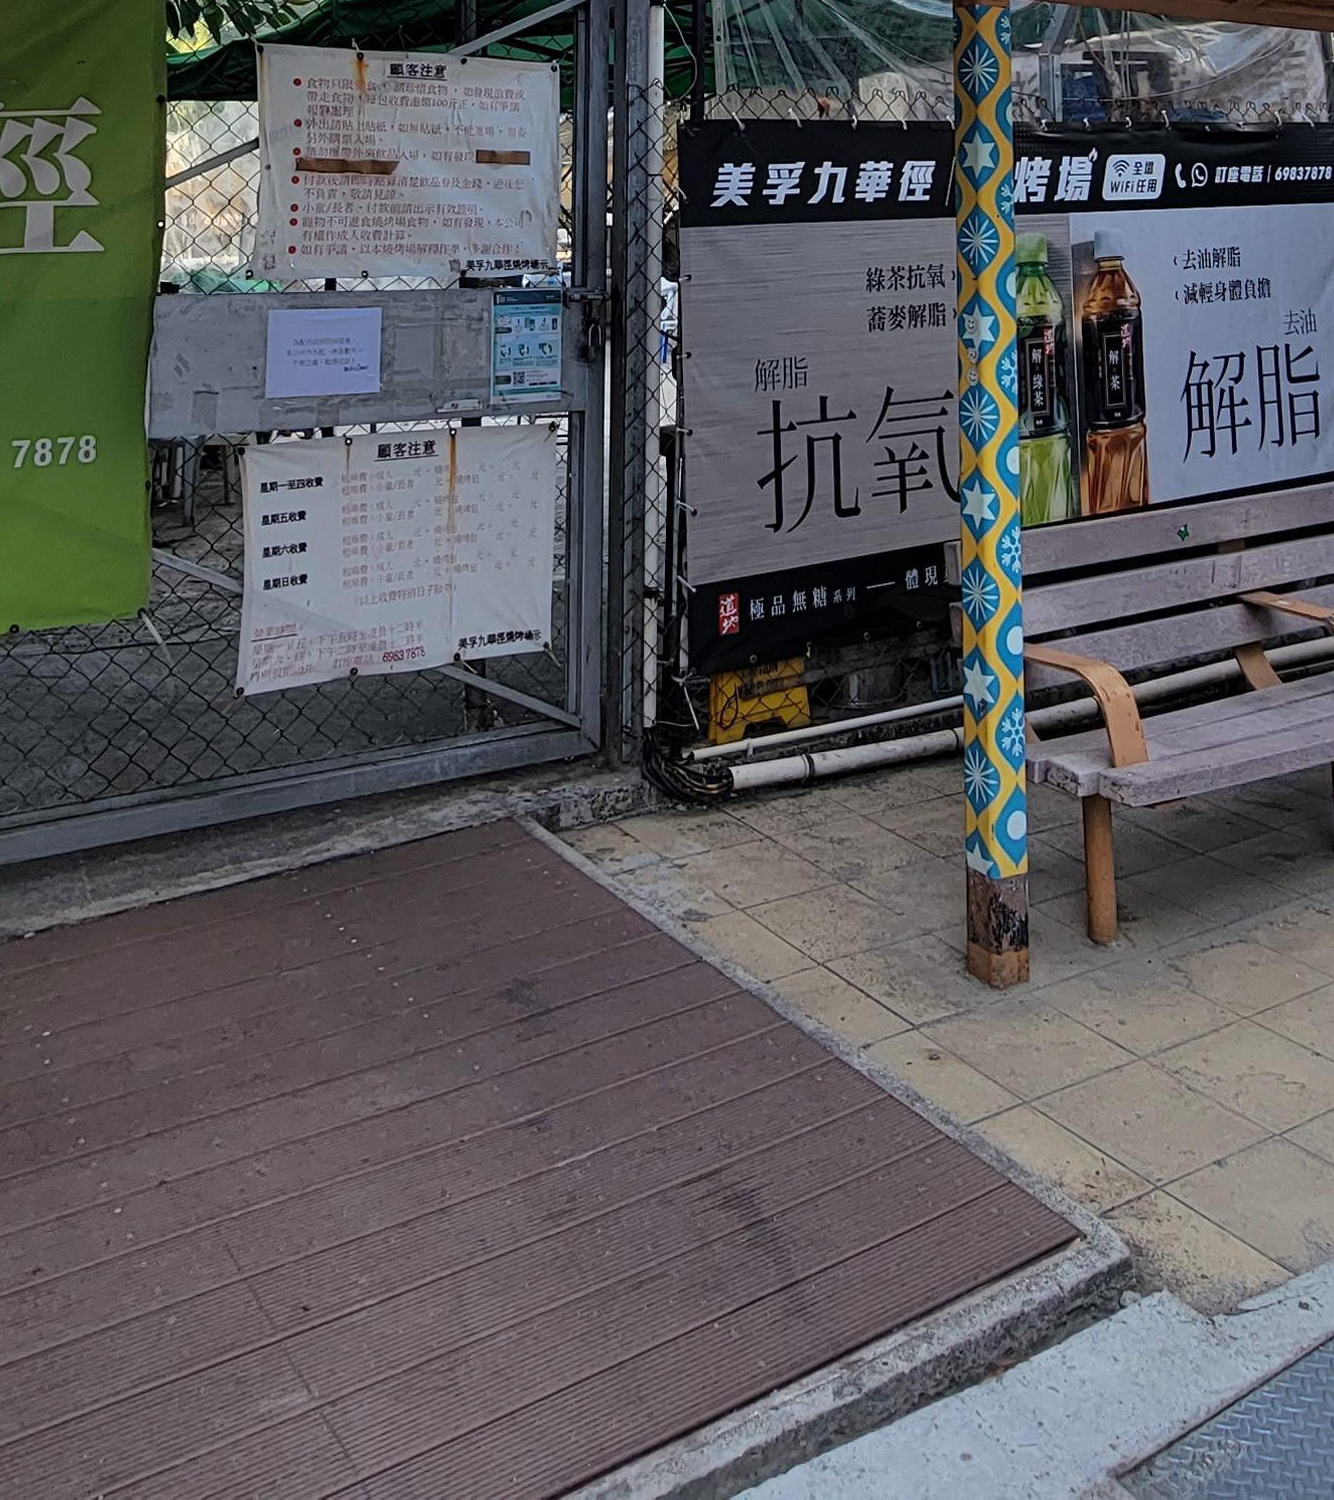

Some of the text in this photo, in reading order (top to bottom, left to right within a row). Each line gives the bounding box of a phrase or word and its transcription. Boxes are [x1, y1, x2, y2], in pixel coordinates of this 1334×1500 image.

[389, 62, 448, 79] 顧客注意
[709, 160, 936, 208] 美孚九華徑
[1013, 155, 1095, 204] 烤場
[1214, 165, 1333, 184] 訂座電話 69837878
[1181, 246, 1242, 271] 去油解脂
[865, 263, 946, 293] 綠茶抗氧
[1183, 277, 1271, 304] 減輕身體負擔
[866, 302, 947, 333] 蕎麥解脂
[1283, 307, 1318, 337] 去油
[754, 355, 809, 393] 解脂
[1179, 342, 1321, 464] 解脂
[11, 434, 98, 469] 7878
[377, 440, 437, 459] 顧客注意
[756, 385, 961, 533] 抗氧
[904, 564, 949, 591] 體現
